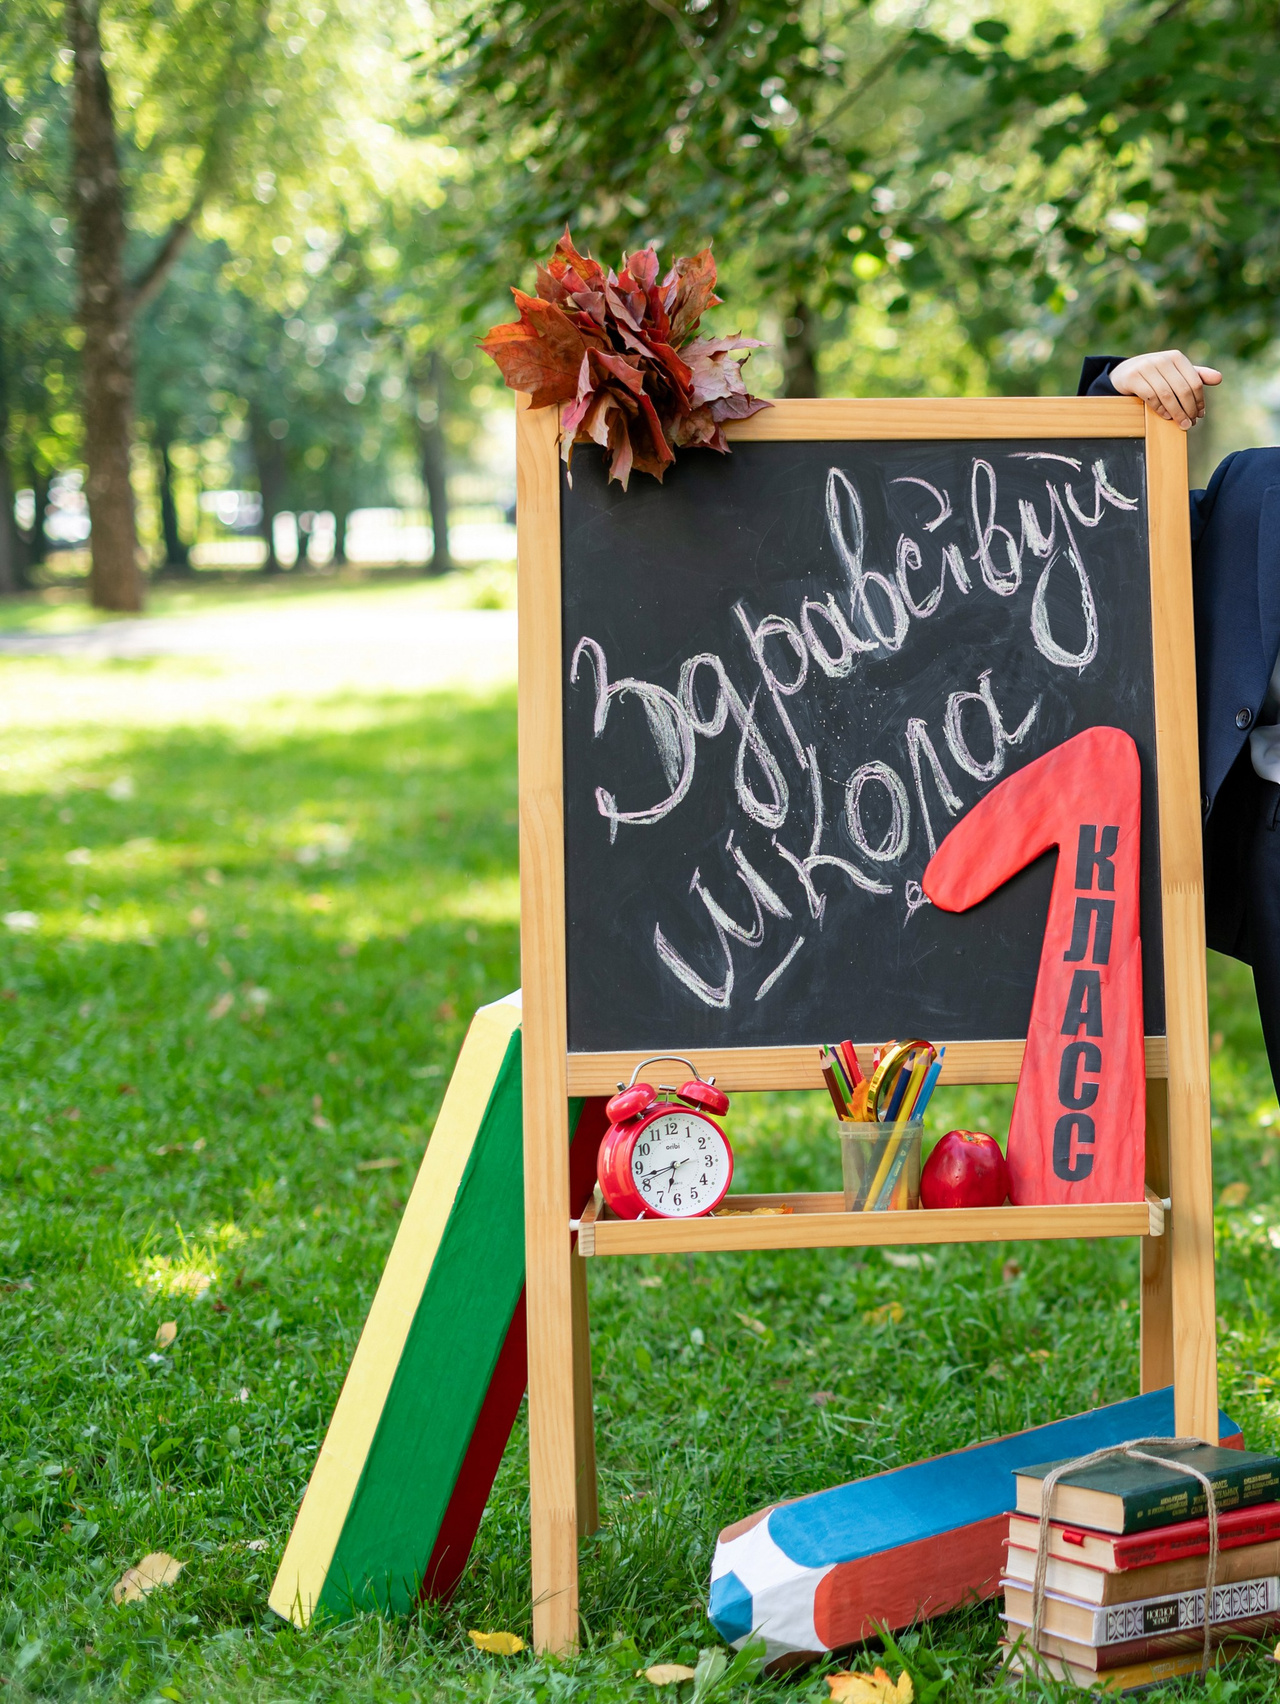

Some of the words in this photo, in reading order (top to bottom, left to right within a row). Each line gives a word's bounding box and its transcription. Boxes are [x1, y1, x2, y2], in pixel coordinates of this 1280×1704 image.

[1053, 824, 1120, 1182] КЛАСС
[649, 1128, 661, 1141] 11
[664, 1122, 679, 1135] 12
[685, 1126, 692, 1138] 1
[697, 1136, 707, 1150] 2
[637, 1143, 650, 1157] 10
[704, 1155, 713, 1167] 3
[635, 1161, 644, 1175] 9
[642, 1178, 652, 1192] 8
[699, 1173, 708, 1186] 4
[656, 1191, 665, 1204] 7
[673, 1193, 682, 1206] 6
[690, 1187, 698, 1199] 5
